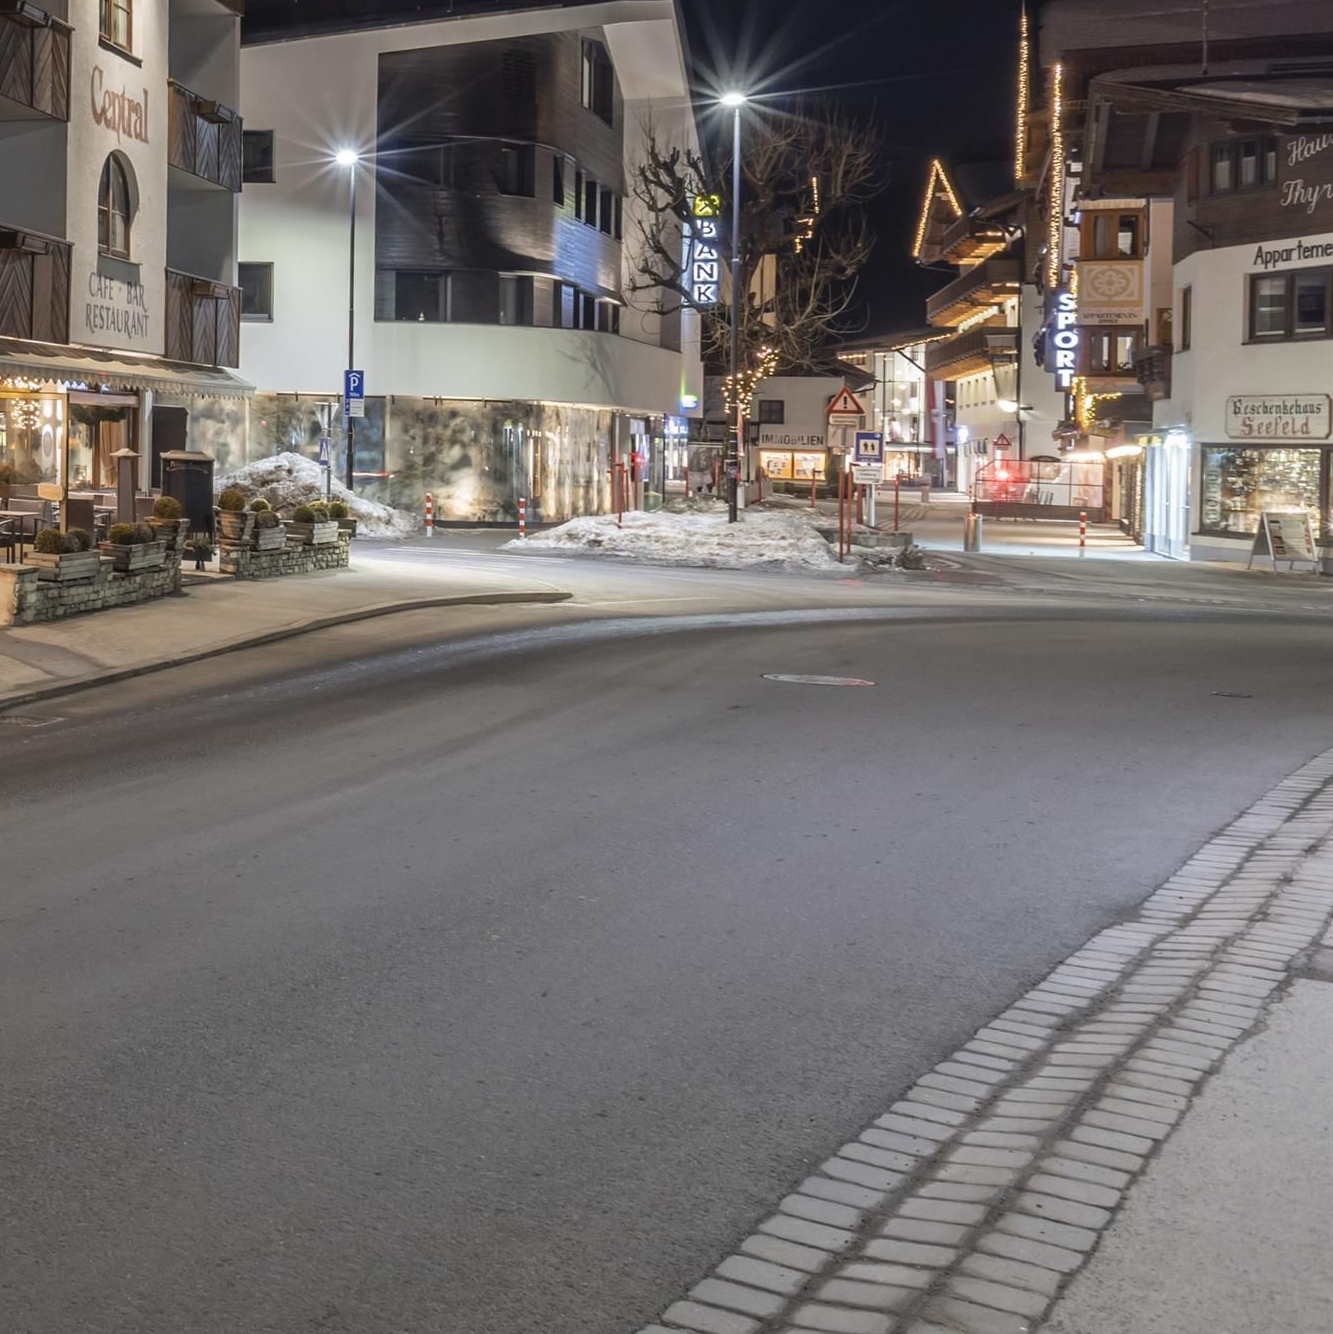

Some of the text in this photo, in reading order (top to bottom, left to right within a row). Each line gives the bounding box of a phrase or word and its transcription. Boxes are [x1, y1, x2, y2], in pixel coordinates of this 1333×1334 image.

[90, 66, 150, 145] Central
[696, 219, 715, 302] BANK
[89, 271, 148, 313] CAFE BAR
[85, 303, 149, 340] RESTAURANT
[1054, 293, 1078, 386] SPORT
[350, 376, 359, 391] P
[1233, 398, 1322, 417] Geschenkehaus
[1240, 415, 1311, 435] Seefeld
